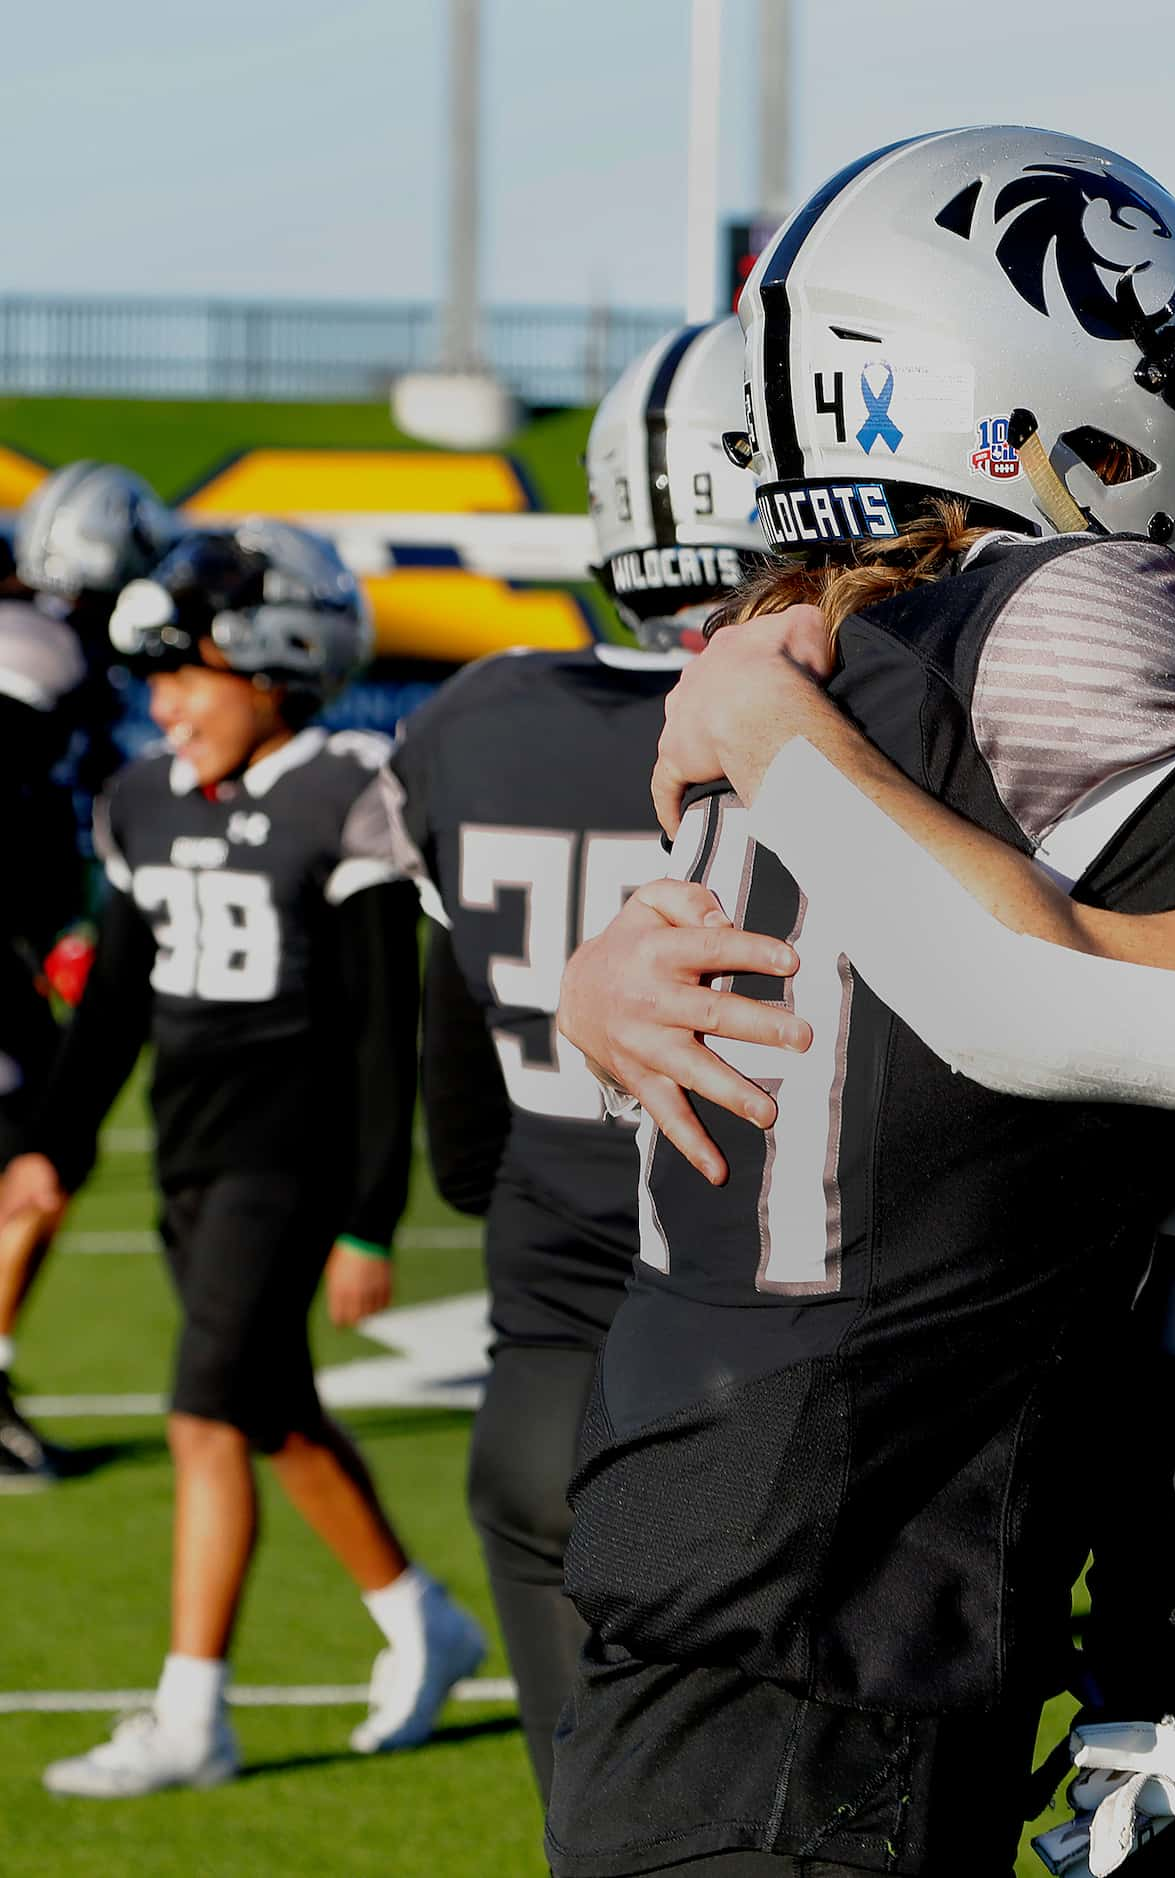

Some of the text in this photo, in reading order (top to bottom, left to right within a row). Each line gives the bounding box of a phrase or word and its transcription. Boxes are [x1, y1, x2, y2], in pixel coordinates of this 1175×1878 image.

[814, 372, 847, 443] 4
[979, 418, 1010, 450] 10
[694, 472, 714, 515] 9
[611, 547, 741, 594] WILDCATS
[132, 866, 282, 1003] 38
